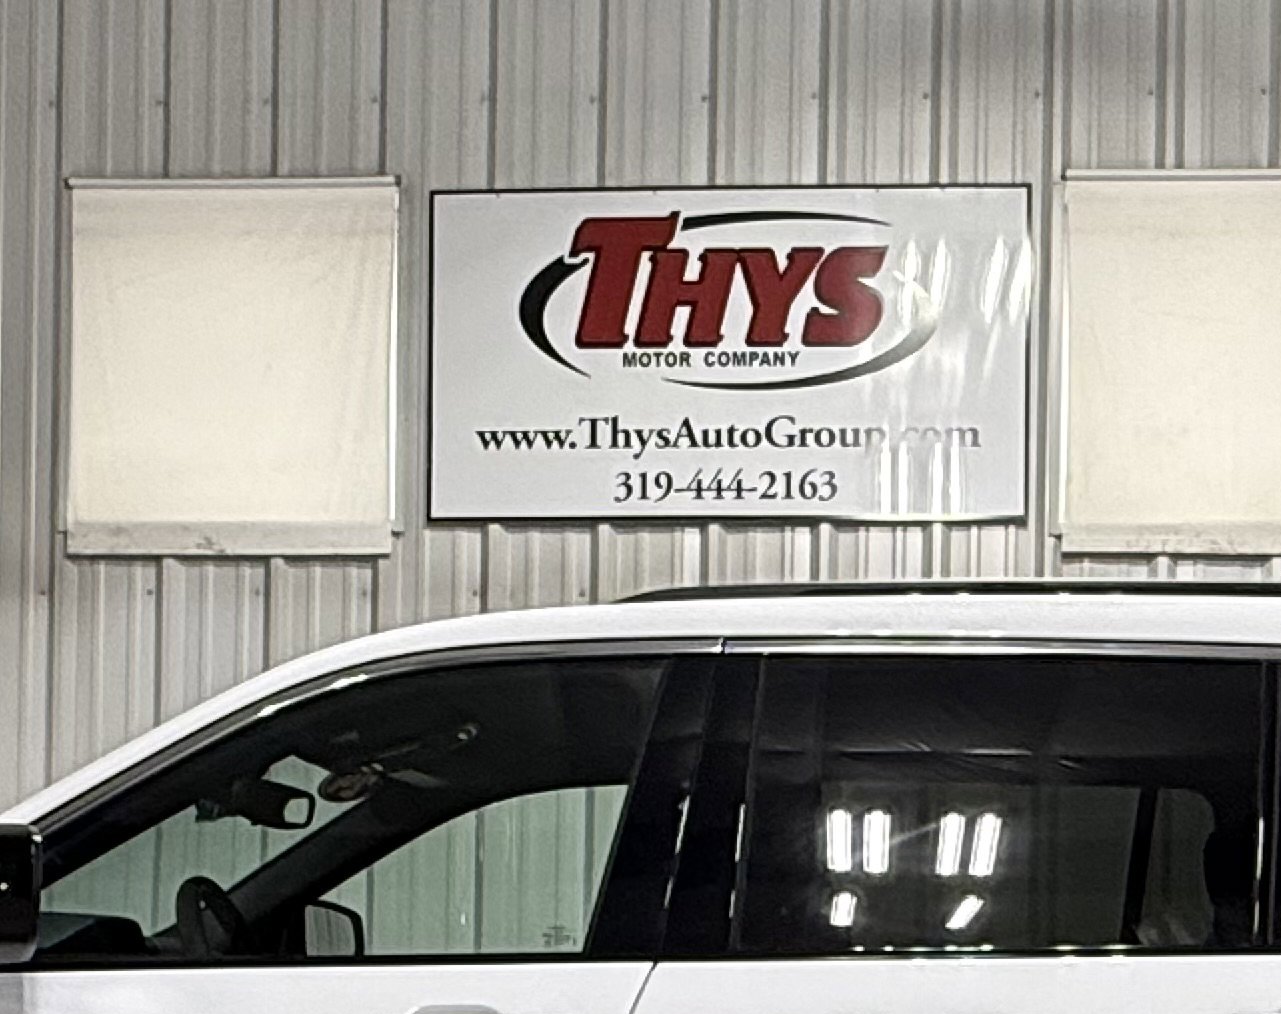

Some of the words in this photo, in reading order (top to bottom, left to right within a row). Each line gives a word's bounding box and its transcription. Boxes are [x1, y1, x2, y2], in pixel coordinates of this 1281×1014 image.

[570, 210, 889, 348] THYS
[622, 351, 692, 368] MOTOR
[703, 350, 800, 368] COMPANY
[475, 415, 981, 460] www.ThysAutoGroupcom
[614, 468, 838, 503] 319-444-2163
